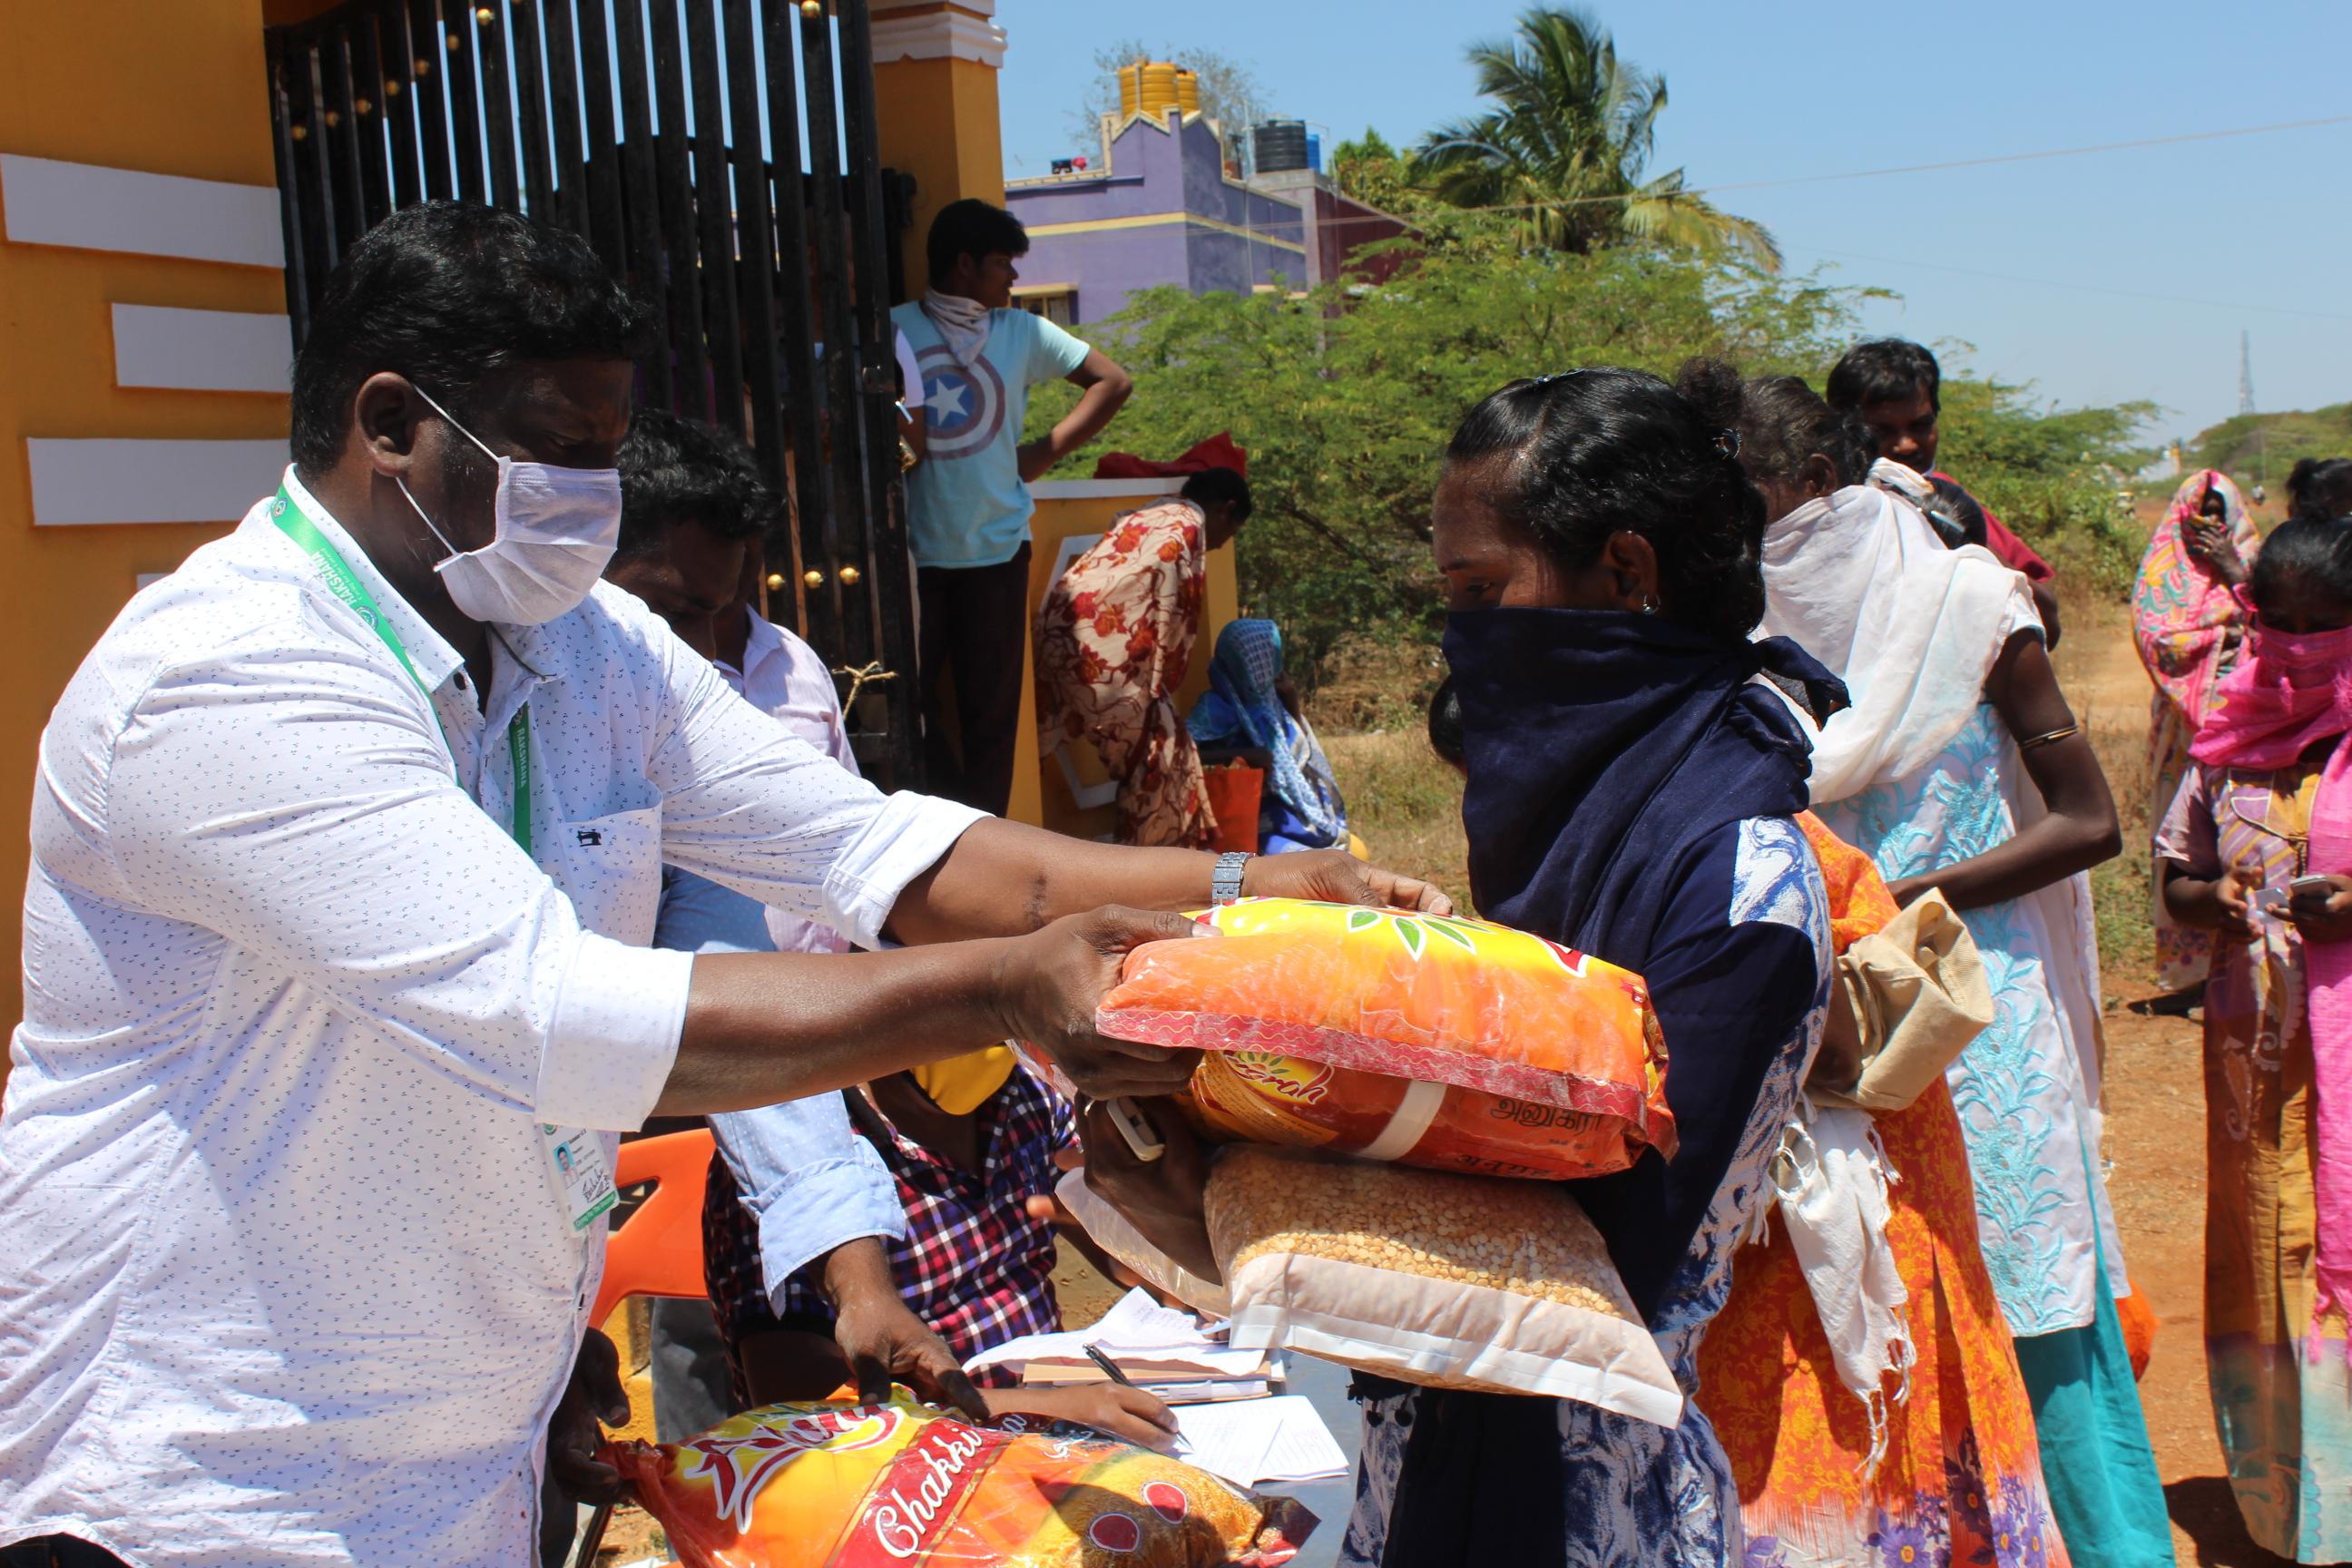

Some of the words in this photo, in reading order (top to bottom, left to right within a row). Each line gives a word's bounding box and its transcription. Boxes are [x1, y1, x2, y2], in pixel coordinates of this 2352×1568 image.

[311, 550, 358, 606] RAKSHANA
[517, 727, 527, 789] RAKSHANA
[875, 1426, 983, 1559] Chakki
